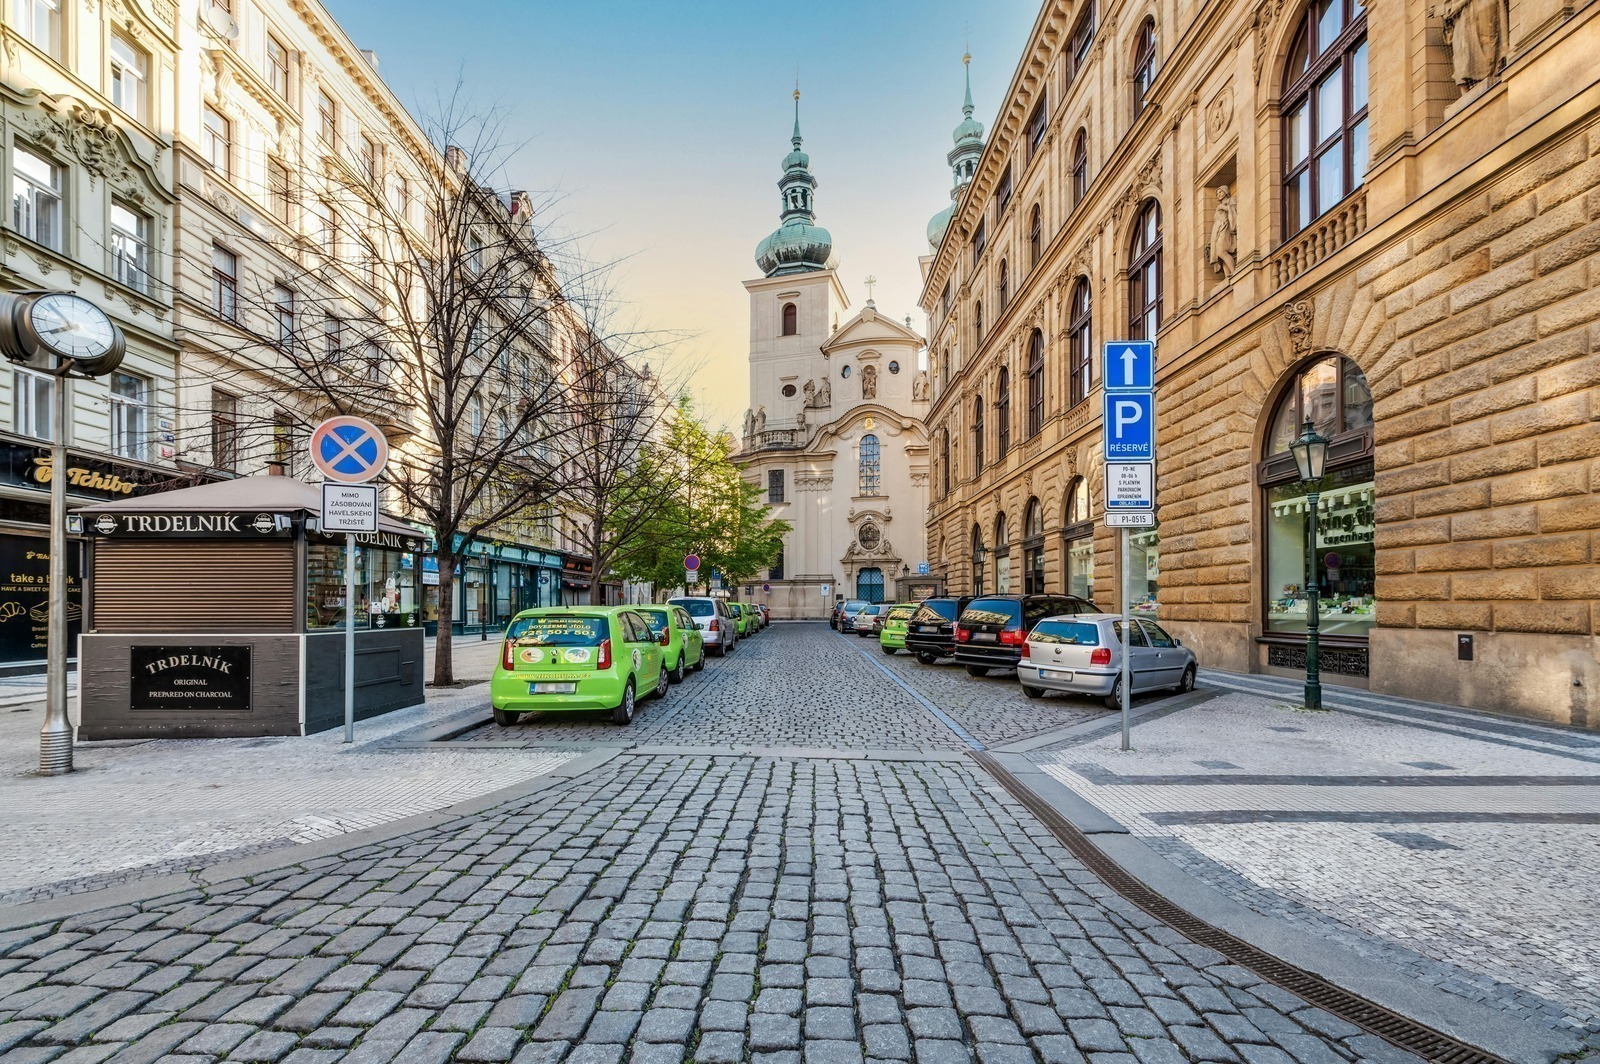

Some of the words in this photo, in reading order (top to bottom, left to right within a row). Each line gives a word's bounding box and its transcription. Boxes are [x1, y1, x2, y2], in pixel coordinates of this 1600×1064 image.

[1115, 400, 1143, 439] P
[1109, 441, 1149, 452] RÉSERVÉ
[67, 467, 138, 494] Tchibo
[330, 500, 372, 508] ZÁSOBOVÁNÍ
[328, 508, 373, 517] HAVELSKÉHO
[122, 511, 241, 533] TRDELNÍK
[339, 518, 365, 526] TRŽIŠTĚ
[1121, 515, 1147, 524] P1-0515
[10, 573, 35, 583] take
[37, 575, 44, 583] a
[145, 654, 233, 675] TRDELNÍK
